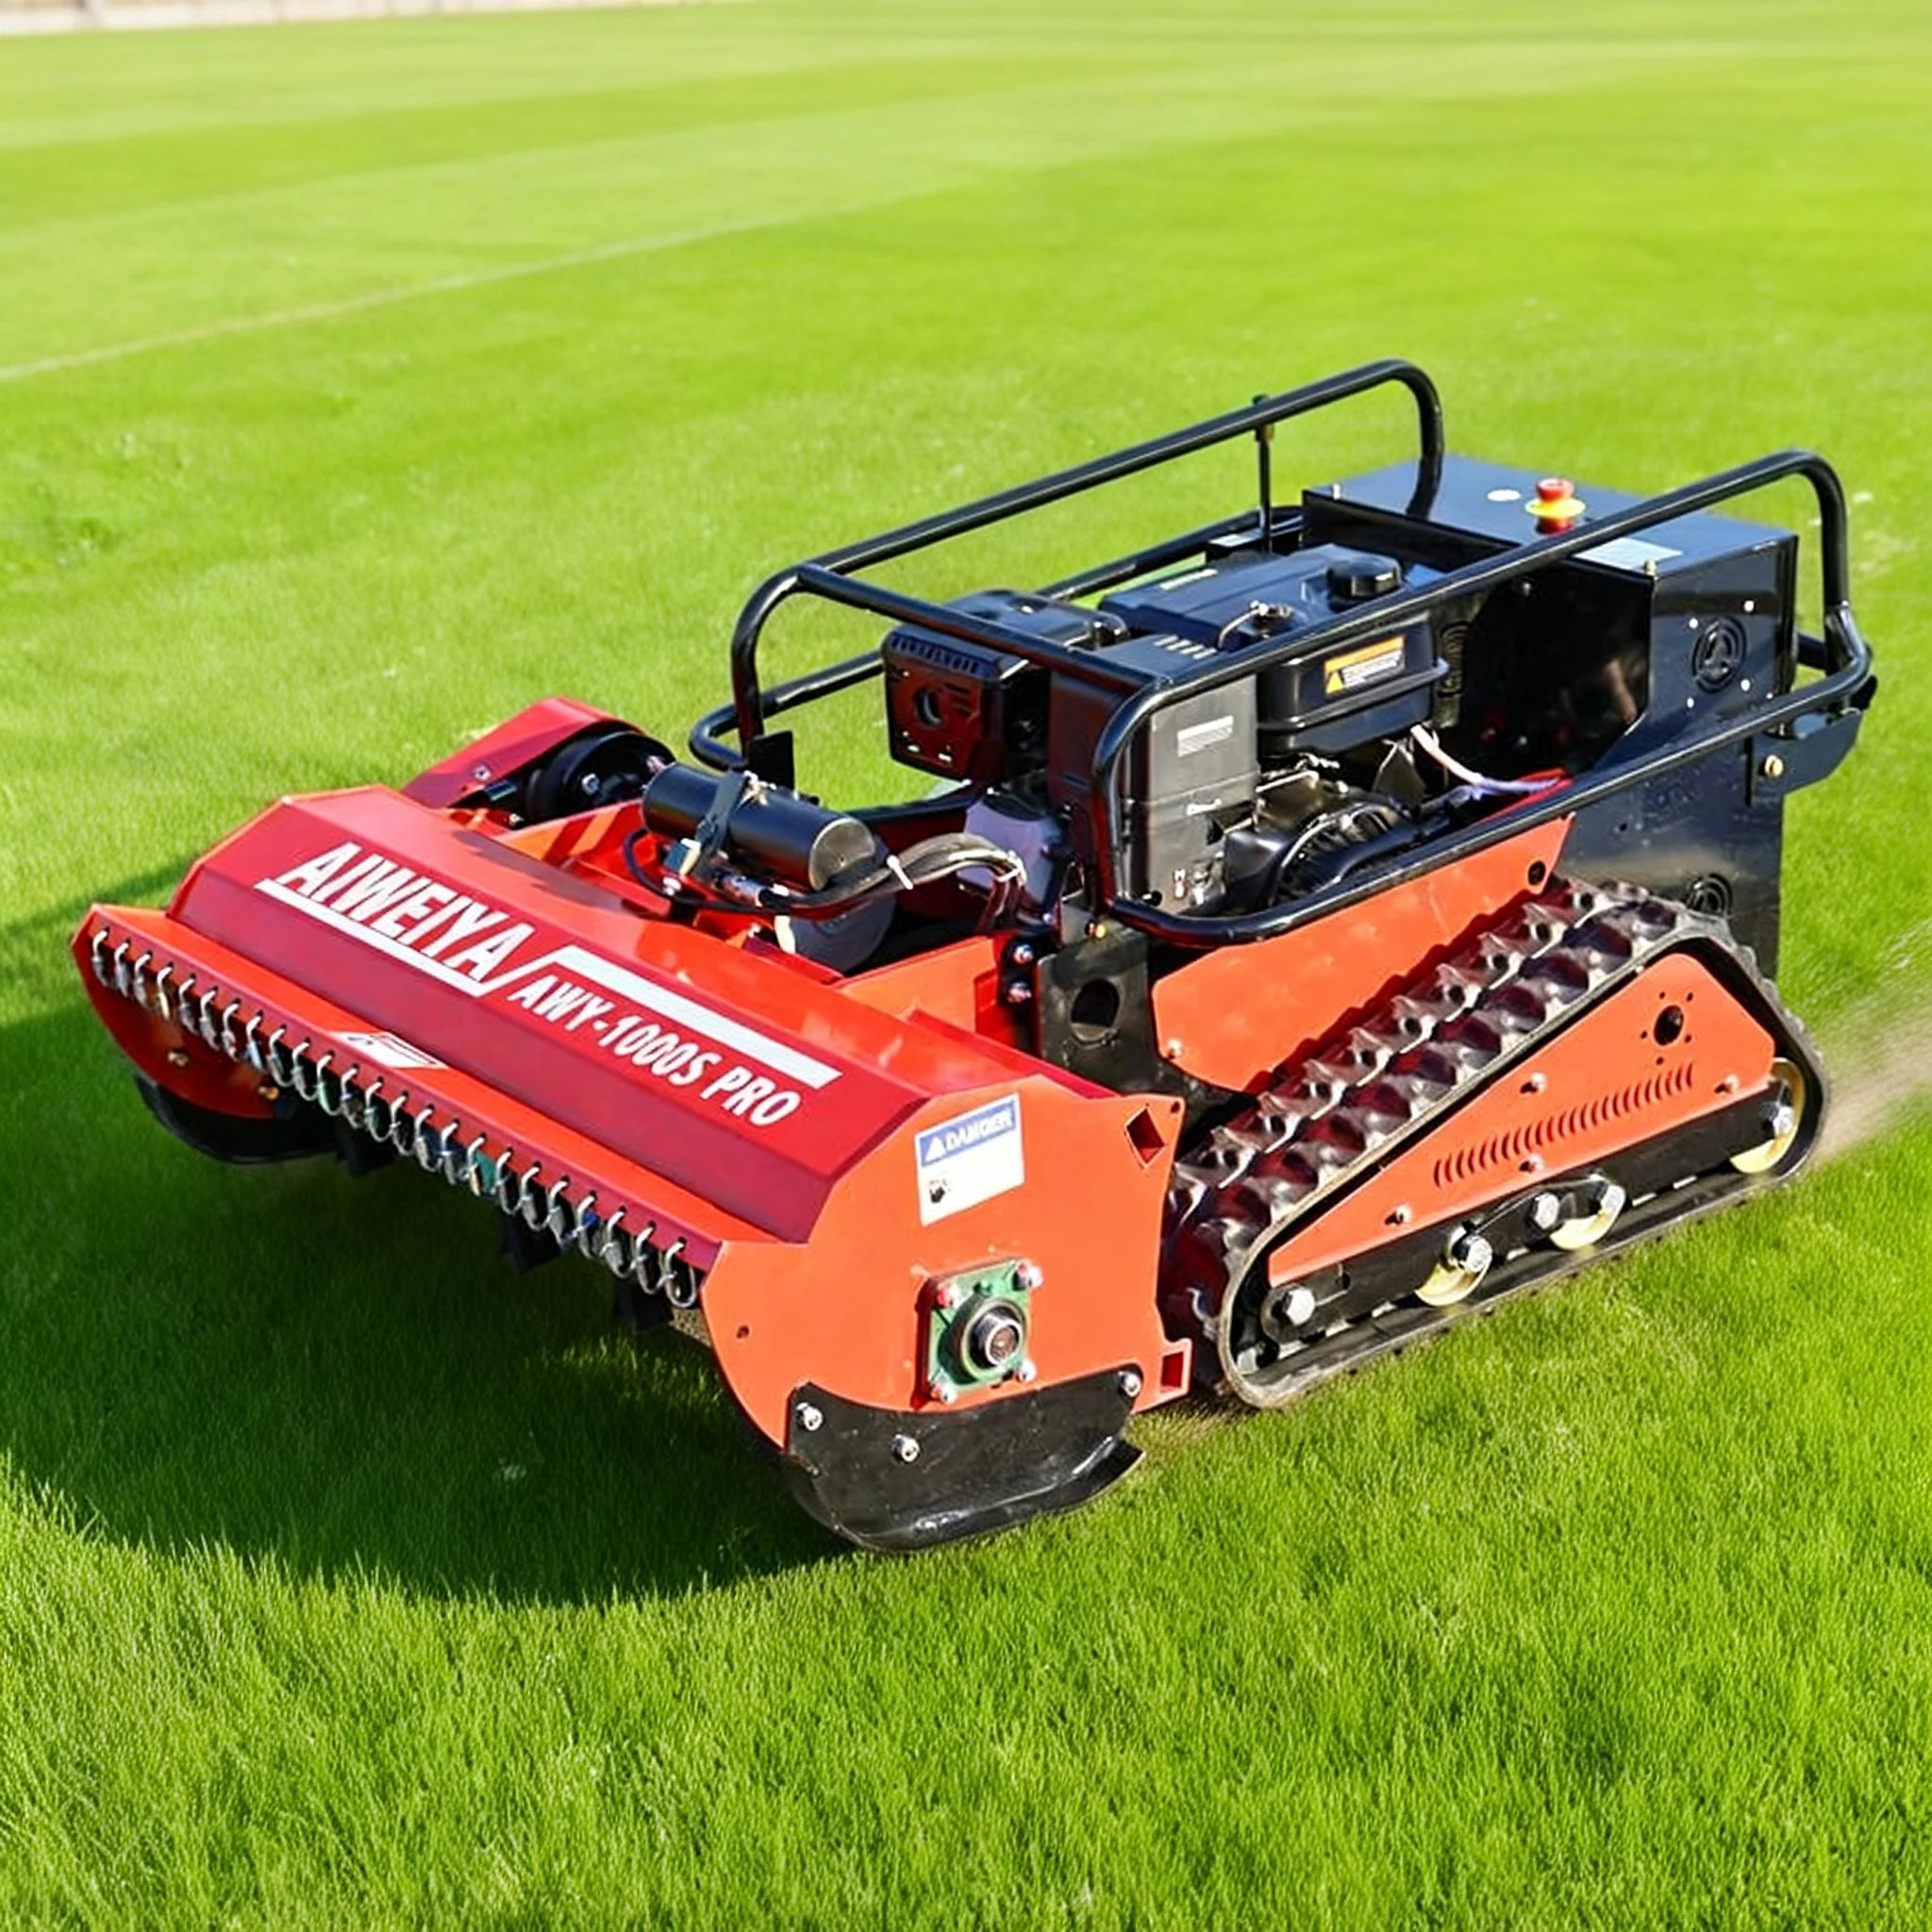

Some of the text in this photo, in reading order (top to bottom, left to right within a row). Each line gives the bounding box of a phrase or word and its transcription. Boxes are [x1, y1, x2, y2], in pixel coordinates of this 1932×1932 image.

[277, 842, 535, 982] AIWEIYA
[509, 974, 801, 1126] AWY-1000S PRO
